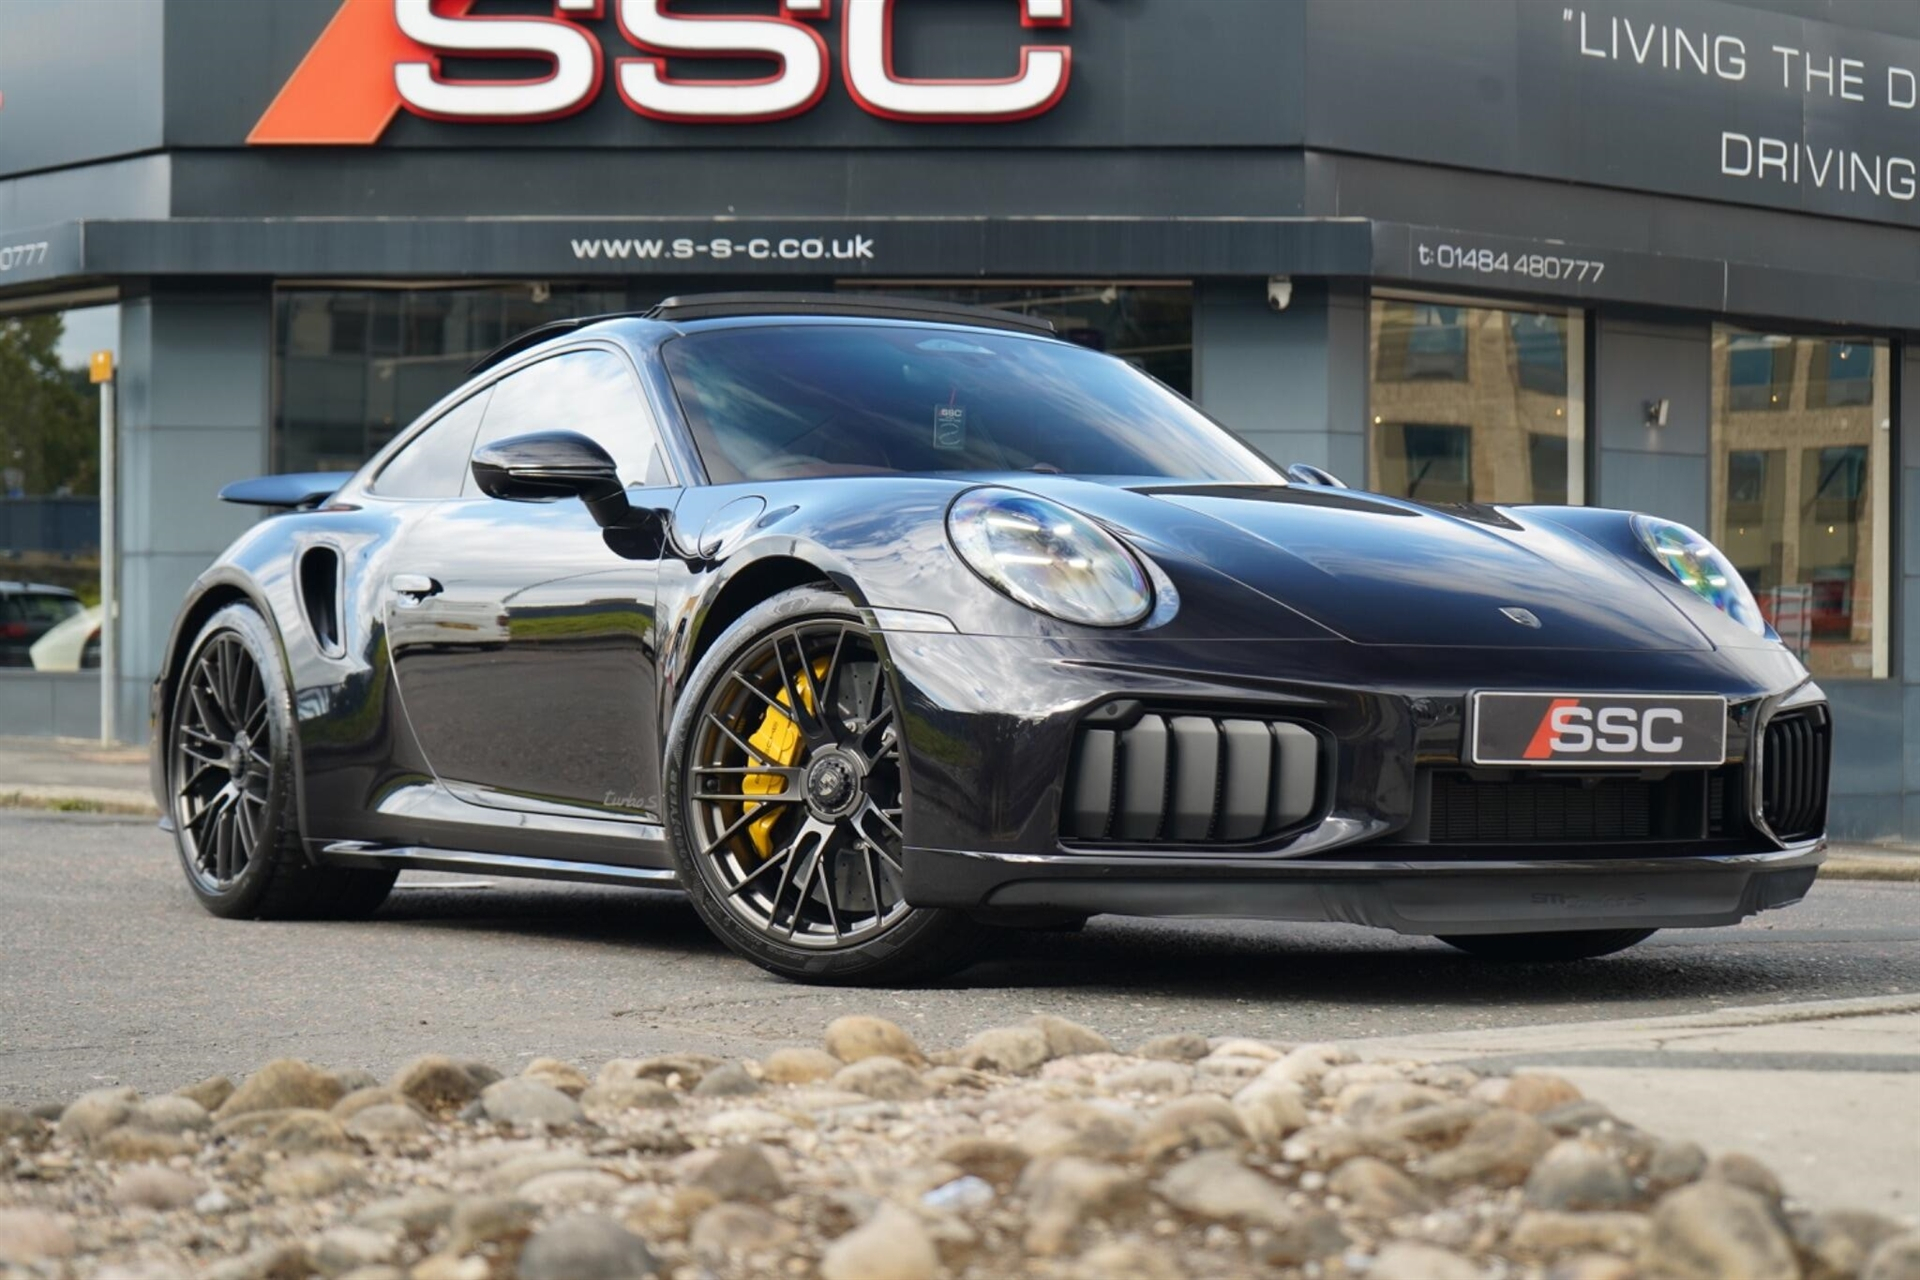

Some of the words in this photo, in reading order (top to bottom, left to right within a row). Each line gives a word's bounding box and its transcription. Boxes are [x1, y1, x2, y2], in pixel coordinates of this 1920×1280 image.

[394, 0, 1073, 122] SSC
[1563, 8, 1747, 81] "LIVING
[1772, 45, 1864, 101] THE
[1887, 66, 1916, 109] D
[1721, 131, 1916, 200] DRIVING
[570, 234, 874, 259] www.s-s-c.co.uk
[1513, 254, 1605, 283] 480777
[1549, 706, 1684, 753] SSC
